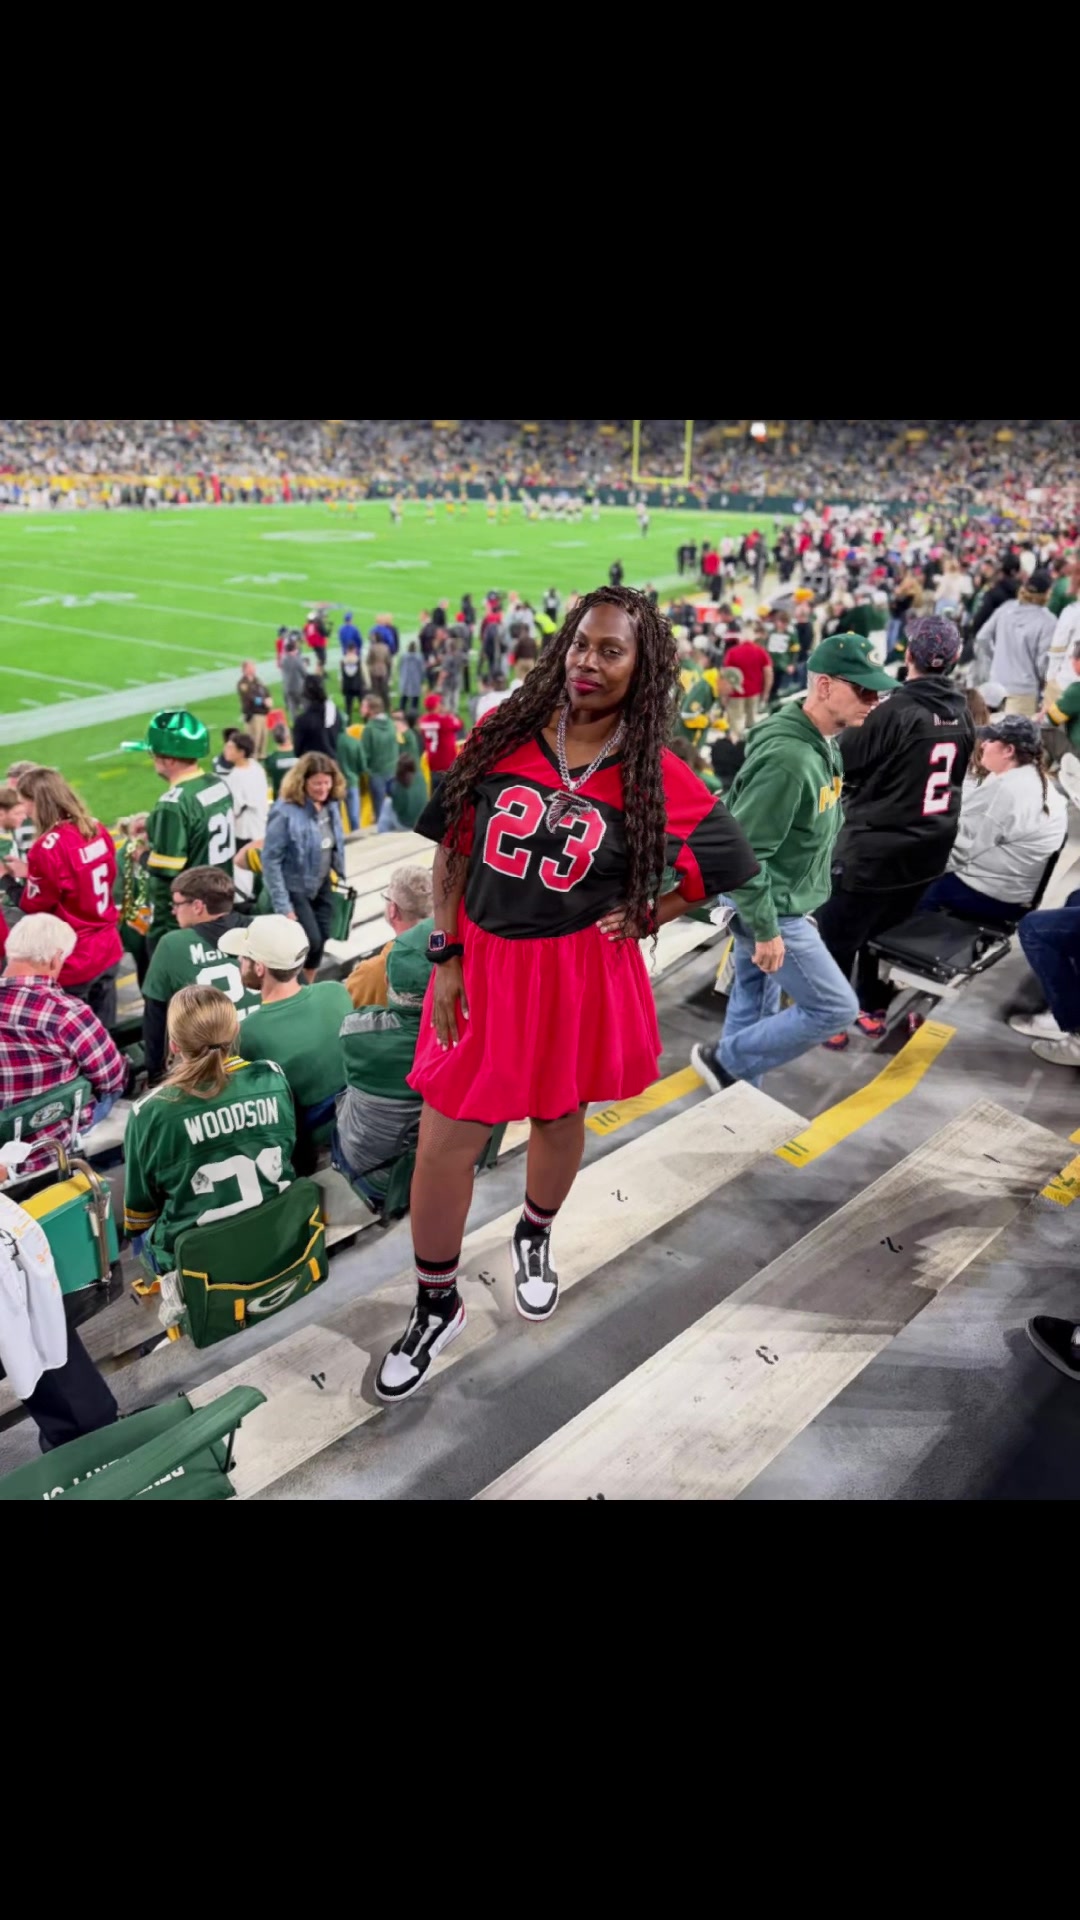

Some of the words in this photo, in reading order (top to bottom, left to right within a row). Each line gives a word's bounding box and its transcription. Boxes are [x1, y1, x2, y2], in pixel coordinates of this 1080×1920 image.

[922, 742, 957, 816] 2
[483, 785, 606, 893] 23
[92, 863, 109, 914] 5
[183, 1096, 279, 1145] WOODSON
[594, 1110, 621, 1127] 10
